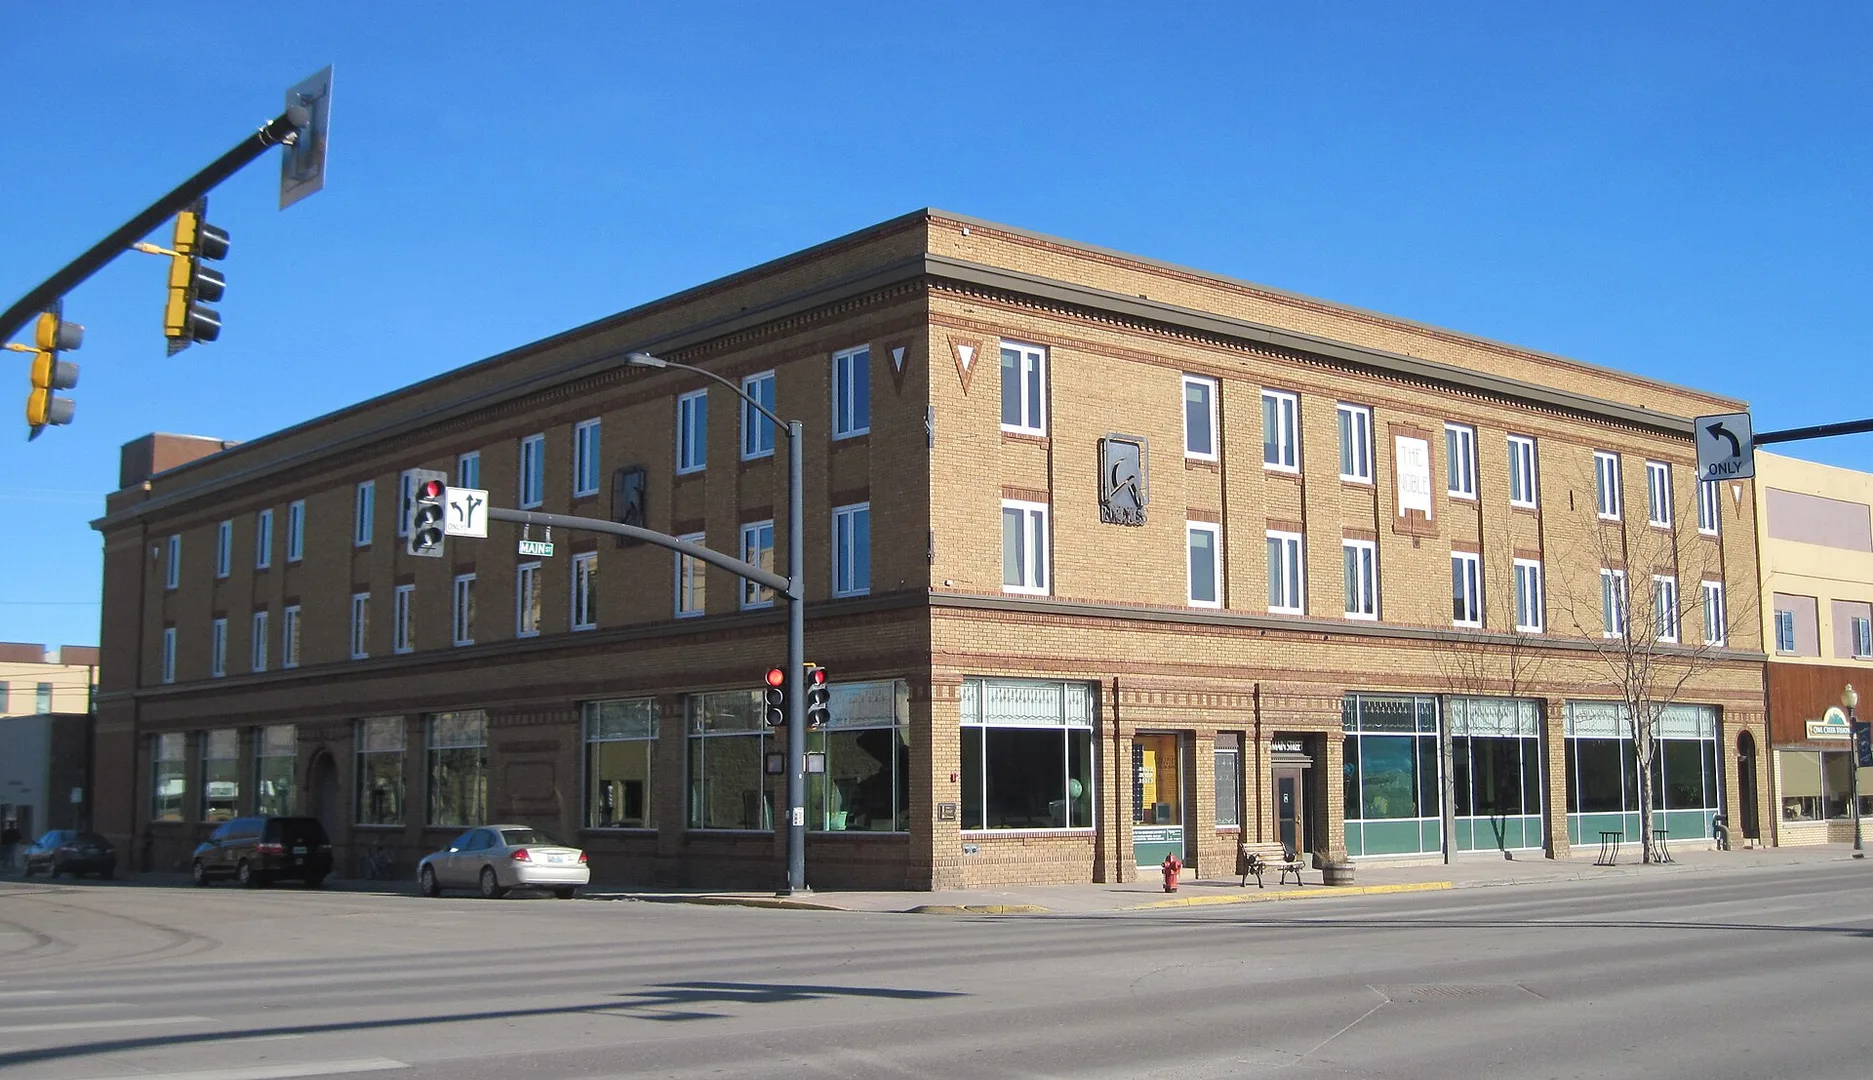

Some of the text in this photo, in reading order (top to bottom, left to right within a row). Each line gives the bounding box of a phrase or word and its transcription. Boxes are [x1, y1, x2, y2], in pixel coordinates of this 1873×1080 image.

[1401, 445, 1423, 467] THE
[1708, 461, 1742, 475] ONLY
[447, 522, 465, 531] ONLY
[520, 541, 545, 554] MAIN
